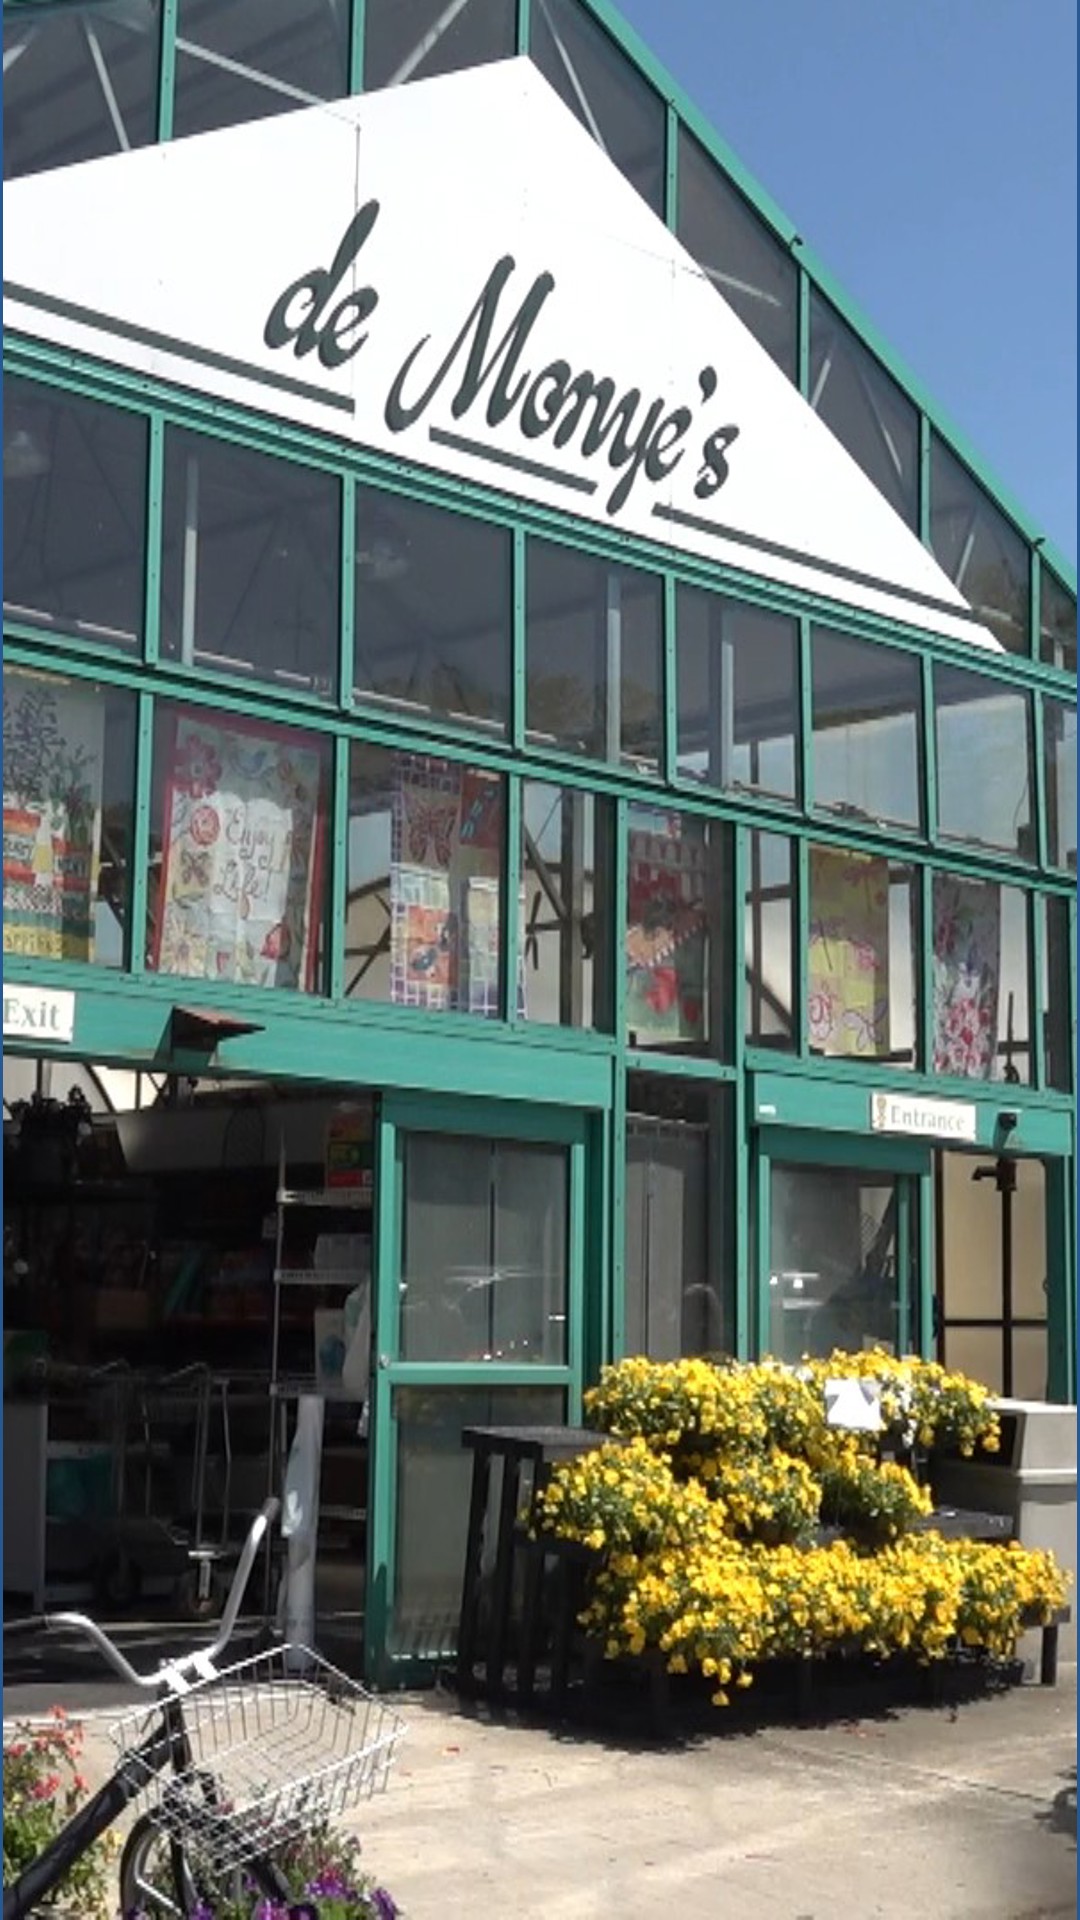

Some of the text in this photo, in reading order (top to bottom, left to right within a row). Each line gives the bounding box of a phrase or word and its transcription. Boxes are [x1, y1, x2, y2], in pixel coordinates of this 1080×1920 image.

[264, 199, 739, 515] de Monye's
[225, 807, 281, 872] Enjoy
[4, 998, 60, 1032] Exit
[891, 1105, 965, 1131] Entrance
